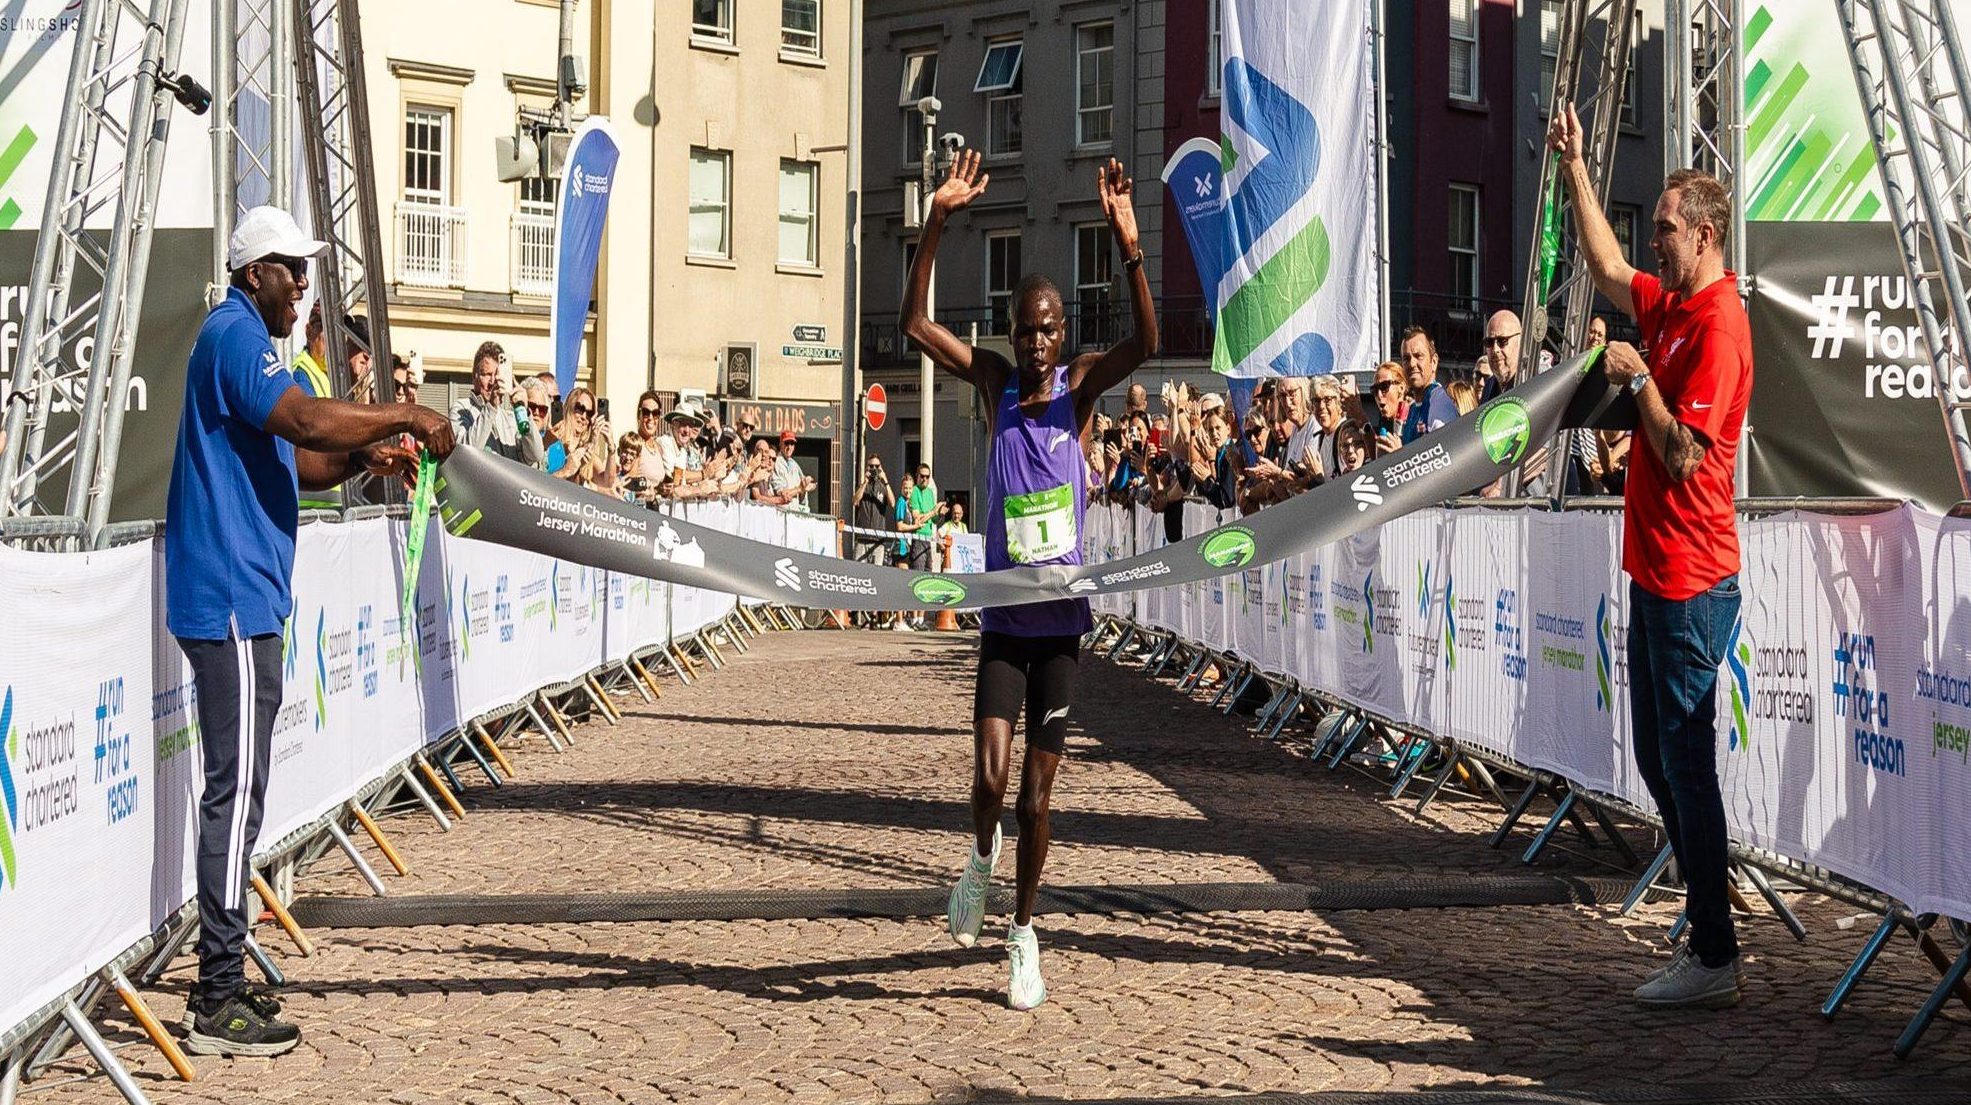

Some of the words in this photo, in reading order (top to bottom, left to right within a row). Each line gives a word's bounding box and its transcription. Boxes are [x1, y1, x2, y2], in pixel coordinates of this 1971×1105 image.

[0, 17, 80, 31] SLINGSHO
[1864, 310, 1922, 359] for
[827, 349, 843, 359] PLAC
[776, 408, 805, 433] DADS
[1382, 443, 1444, 478] standard
[1386, 452, 1452, 488] chartered
[520, 489, 580, 515] Standard
[583, 504, 647, 531] Chartered
[537, 511, 579, 535] Jersey
[581, 519, 646, 546] Marathon
[1037, 520, 1048, 543] 1
[808, 569, 872, 588] standard
[809, 580, 877, 596] chartered
[1101, 561, 1165, 582] standard
[1104, 566, 1171, 585] chartered
[1756, 641, 1807, 679] standard
[1755, 686, 1813, 724] chartered
[1853, 672, 1873, 723] for
[1878, 691, 1888, 728] a
[25, 710, 75, 774] standard
[107, 722, 122, 776] for
[124, 732, 130, 771] a
[1855, 727, 1906, 777] reason
[1932, 711, 1971, 766] jersey
[25, 764, 78, 832] chartered
[107, 774, 138, 826] reason
